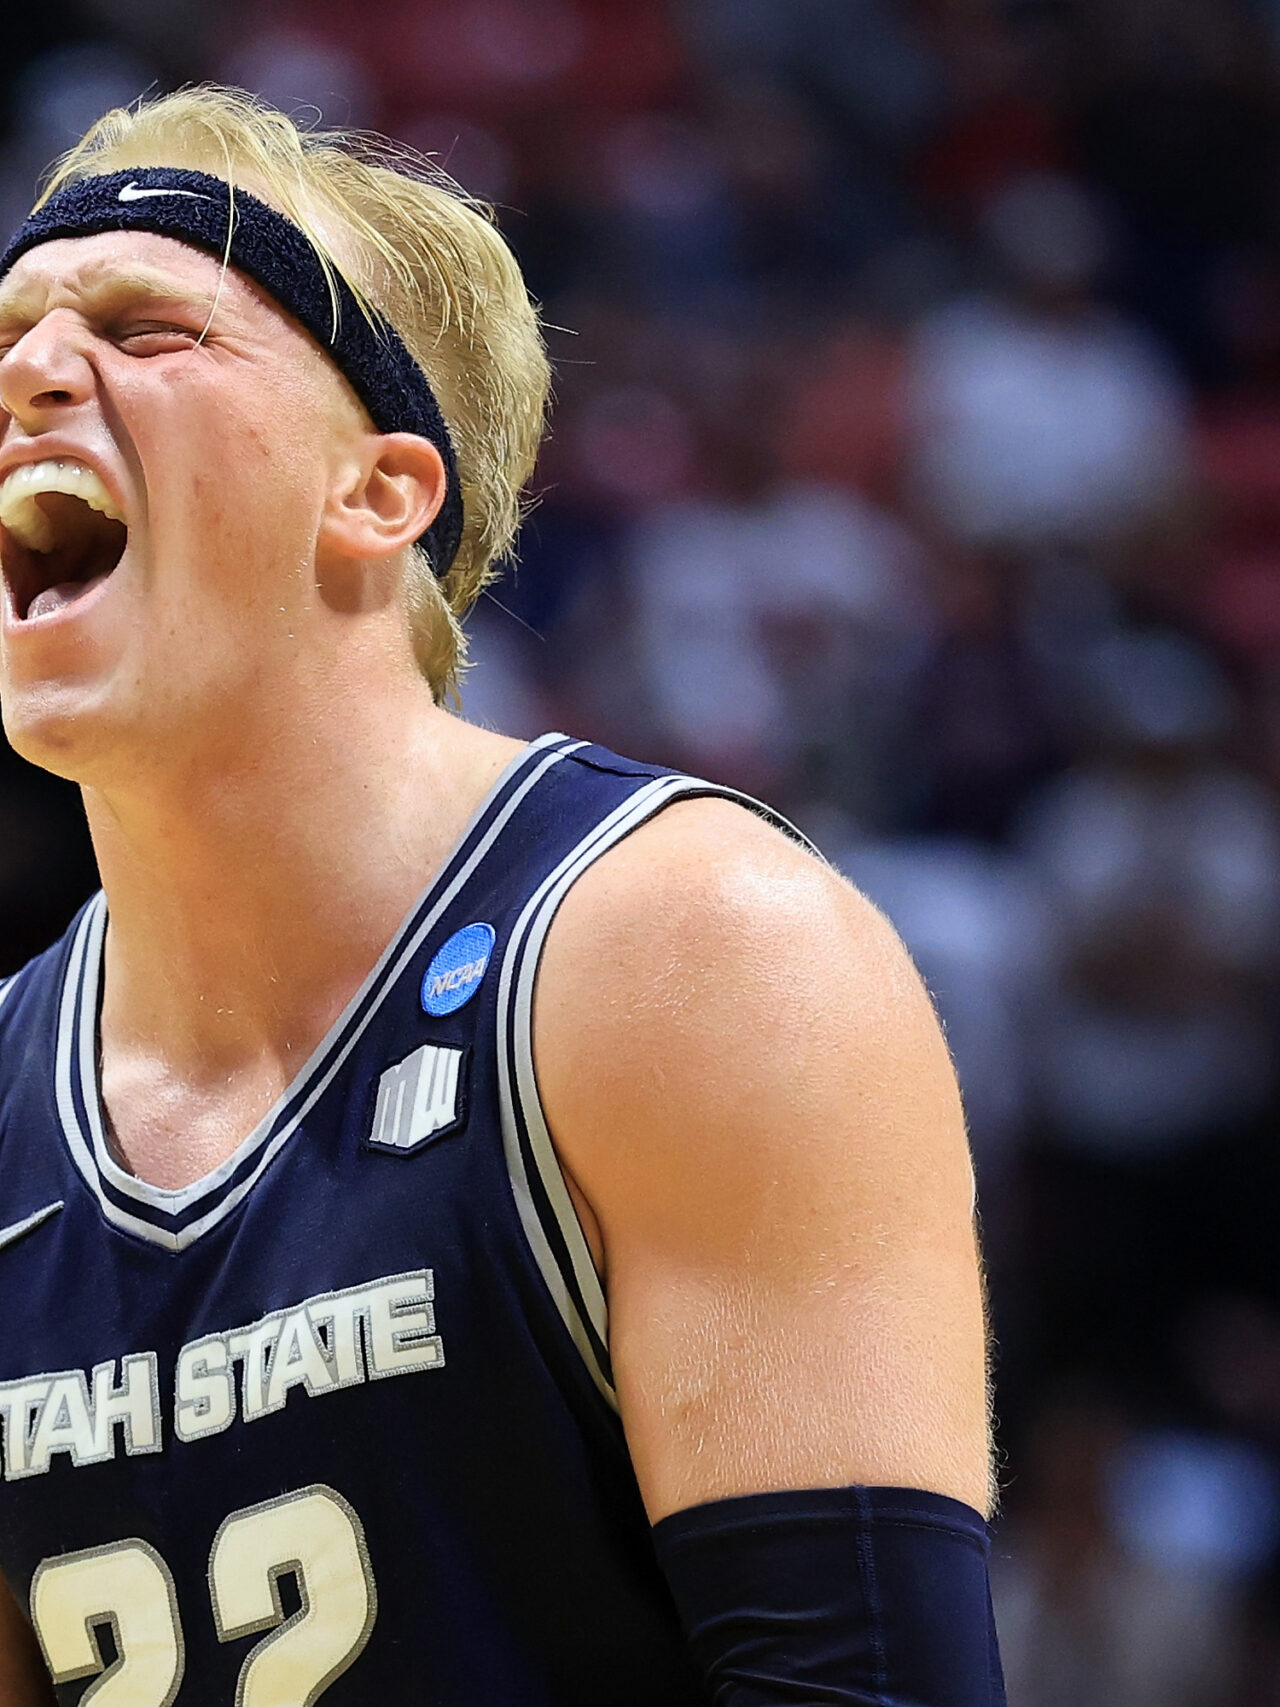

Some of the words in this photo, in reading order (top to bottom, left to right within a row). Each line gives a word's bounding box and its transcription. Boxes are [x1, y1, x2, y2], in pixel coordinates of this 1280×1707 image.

[429, 956, 486, 997] NCAA
[174, 1268, 445, 1442] STATE
[29, 1483, 378, 1707] 22
